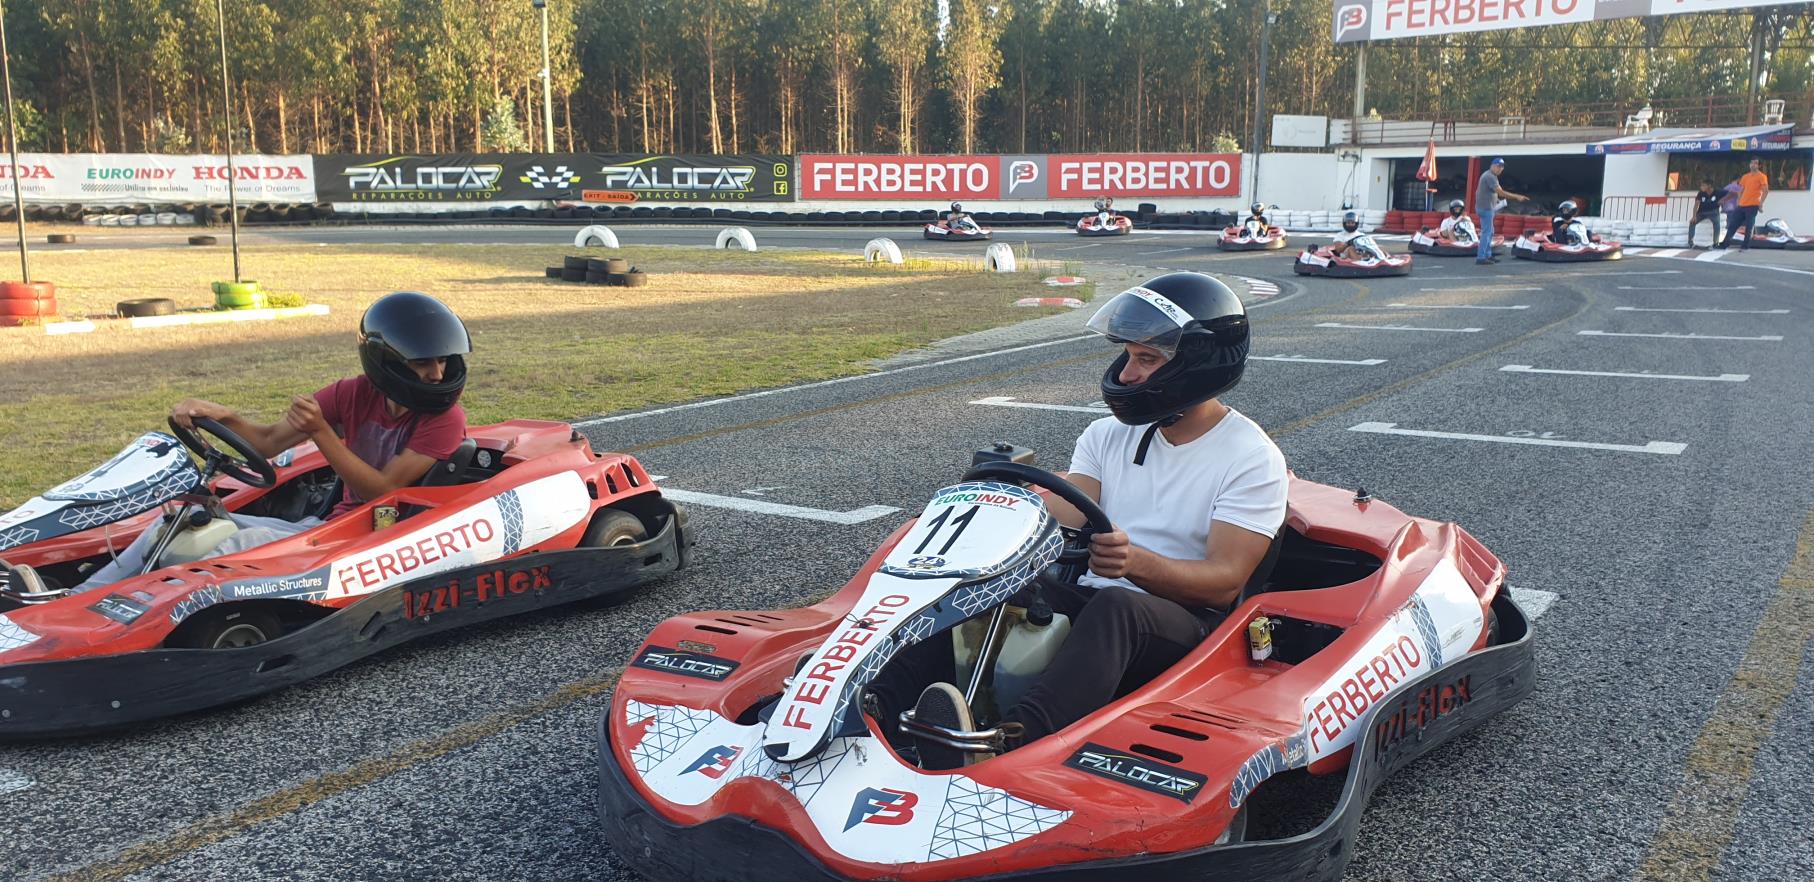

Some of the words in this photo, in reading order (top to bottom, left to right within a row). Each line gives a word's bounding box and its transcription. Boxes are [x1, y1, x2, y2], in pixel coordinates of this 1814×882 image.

[87, 168, 176, 179] EUROINDY
[192, 166, 307, 180] HONDA
[345, 166, 501, 190] PALOCAR
[602, 166, 754, 189] PALOCAR
[814, 162, 989, 192] FERBERTO
[1061, 160, 1231, 191] FERBERTO
[352, 191, 443, 200] REPARAÇÕES
[456, 191, 492, 199] AUTO
[935, 493, 1021, 507] EUROINDY
[913, 505, 981, 555] 11
[338, 518, 494, 594] FERBERTO
[234, 582, 278, 597] Metallic
[280, 576, 322, 592] Structures
[644, 653, 733, 677] PALOCAR
[783, 594, 910, 730] FERBERTO
[1308, 635, 1421, 754] FERBERTO
[1078, 752, 1200, 793] PALOCAR
